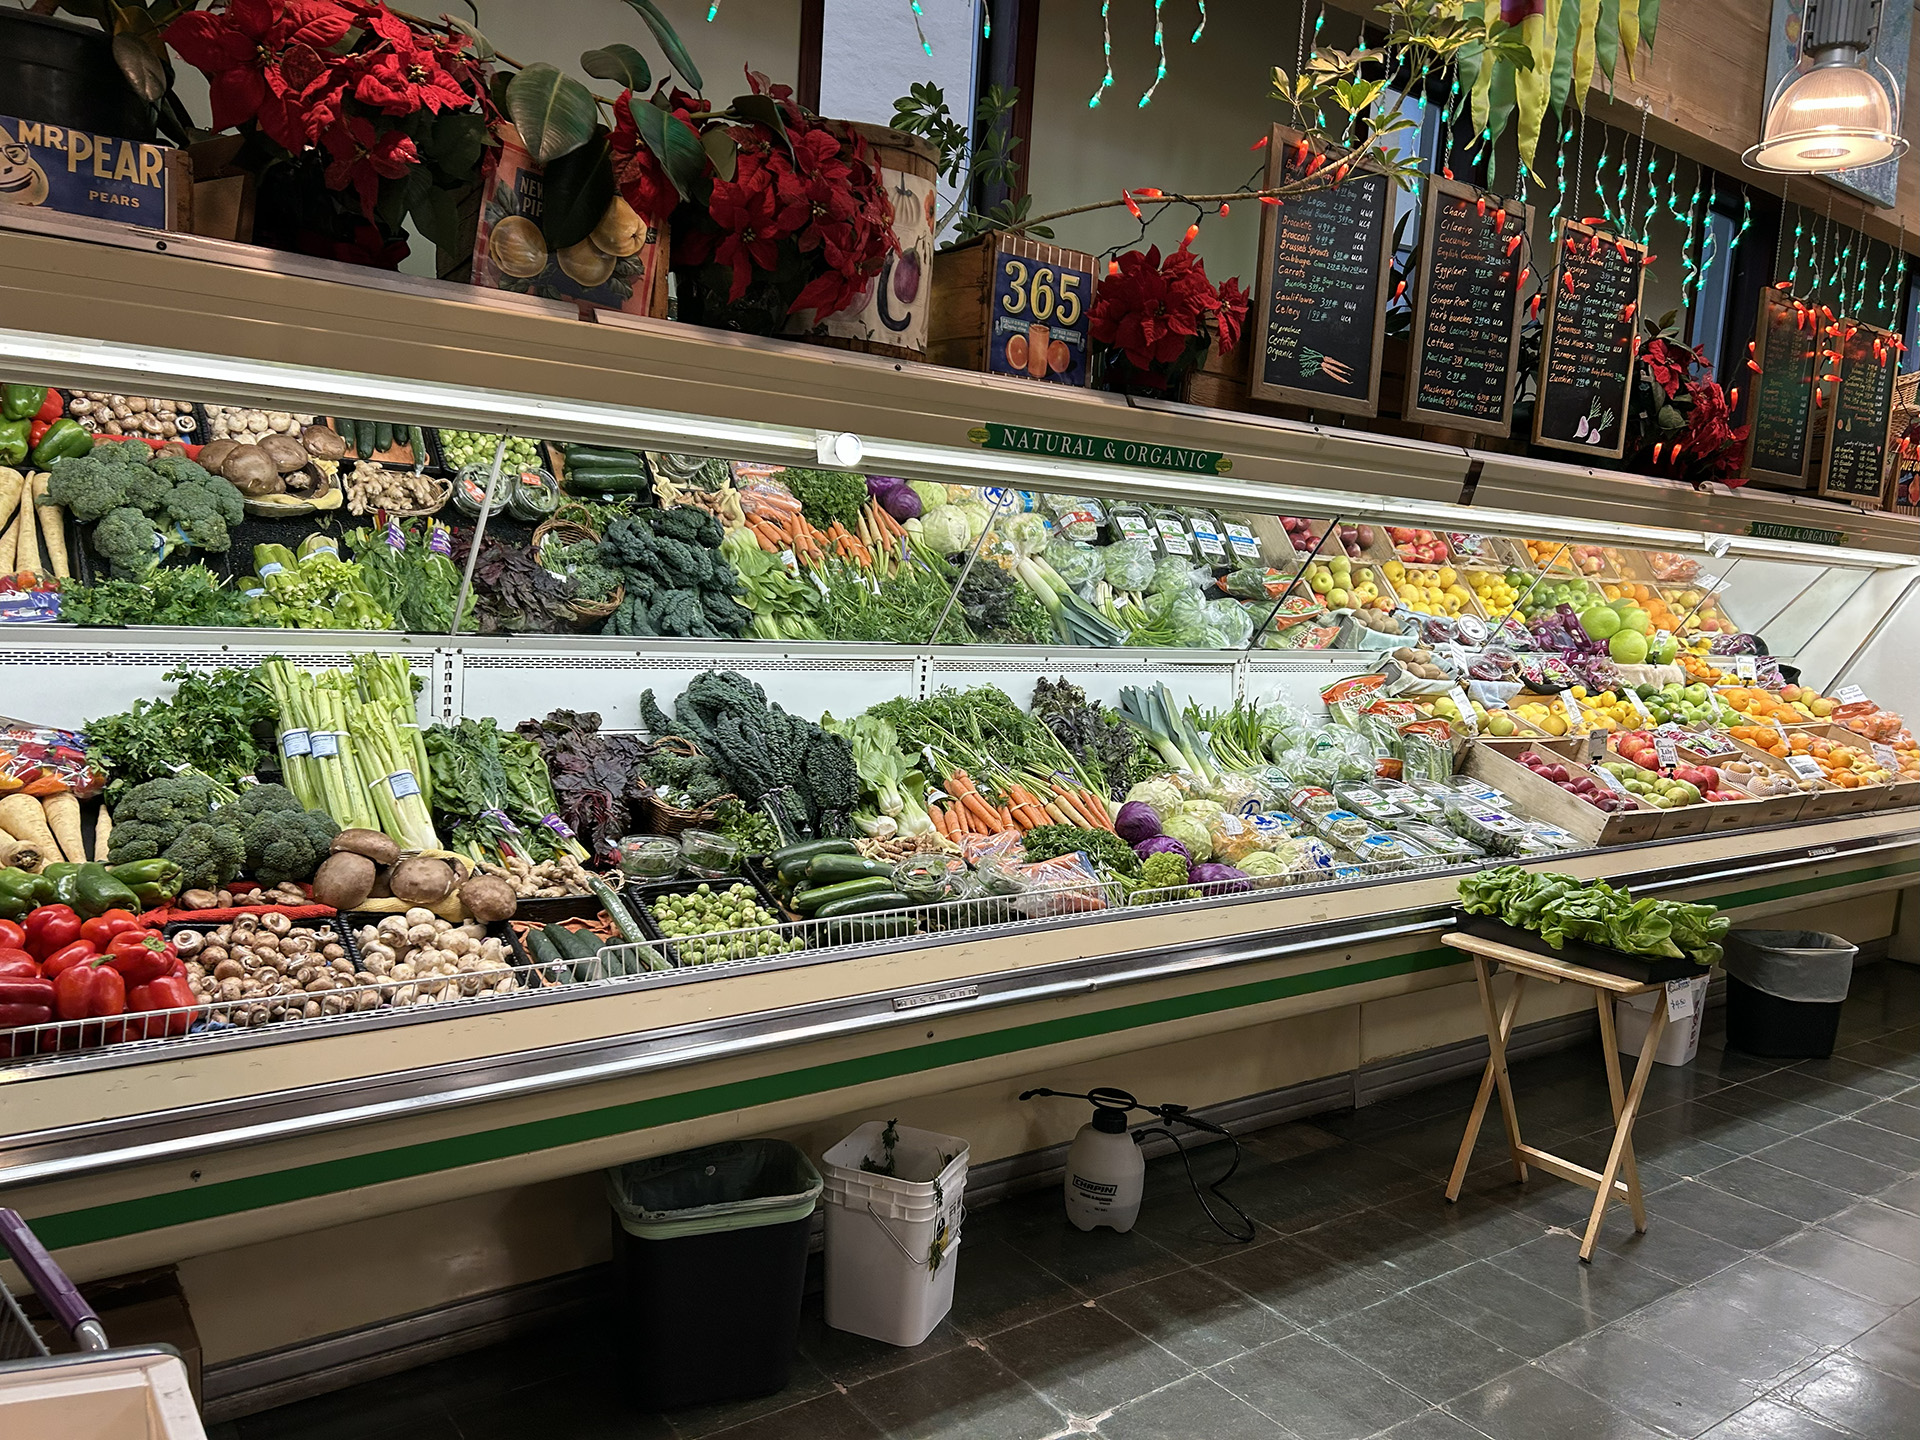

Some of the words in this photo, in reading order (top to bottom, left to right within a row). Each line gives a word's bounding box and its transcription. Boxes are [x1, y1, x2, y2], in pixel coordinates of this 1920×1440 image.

[18, 120, 68, 151] MR.
[68, 130, 163, 188] PEAR
[89, 190, 140, 208] PEARS
[1443, 205, 1467, 218] Chard
[1441, 220, 1472, 234] Cilantro
[1439, 233, 1471, 247] Cucumber
[1279, 253, 1312, 268] Cabbage
[1278, 265, 1306, 278] Carrots
[1434, 263, 1467, 279] Eggplant
[1433, 281, 1457, 291] Fennel
[1003, 261, 1080, 326] 365
[1275, 290, 1315, 305] Cauliflower
[1275, 304, 1301, 321] Celery
[1430, 309, 1447, 320] Herb
[1429, 322, 1446, 333] Kale
[1268, 335, 1299, 347] Certified
[1426, 337, 1454, 350] Lettuce
[1424, 367, 1442, 379] Leeks
[1002, 428, 1095, 457] NATURAL
[1103, 442, 1116, 459] &
[1124, 445, 1207, 469] ORGANIC
[1756, 524, 1793, 539] NATURAL
[1794, 530, 1800, 539] &
[1802, 531, 1838, 543] ORGANIC
[1075, 1178, 1113, 1193] CHAPIN
